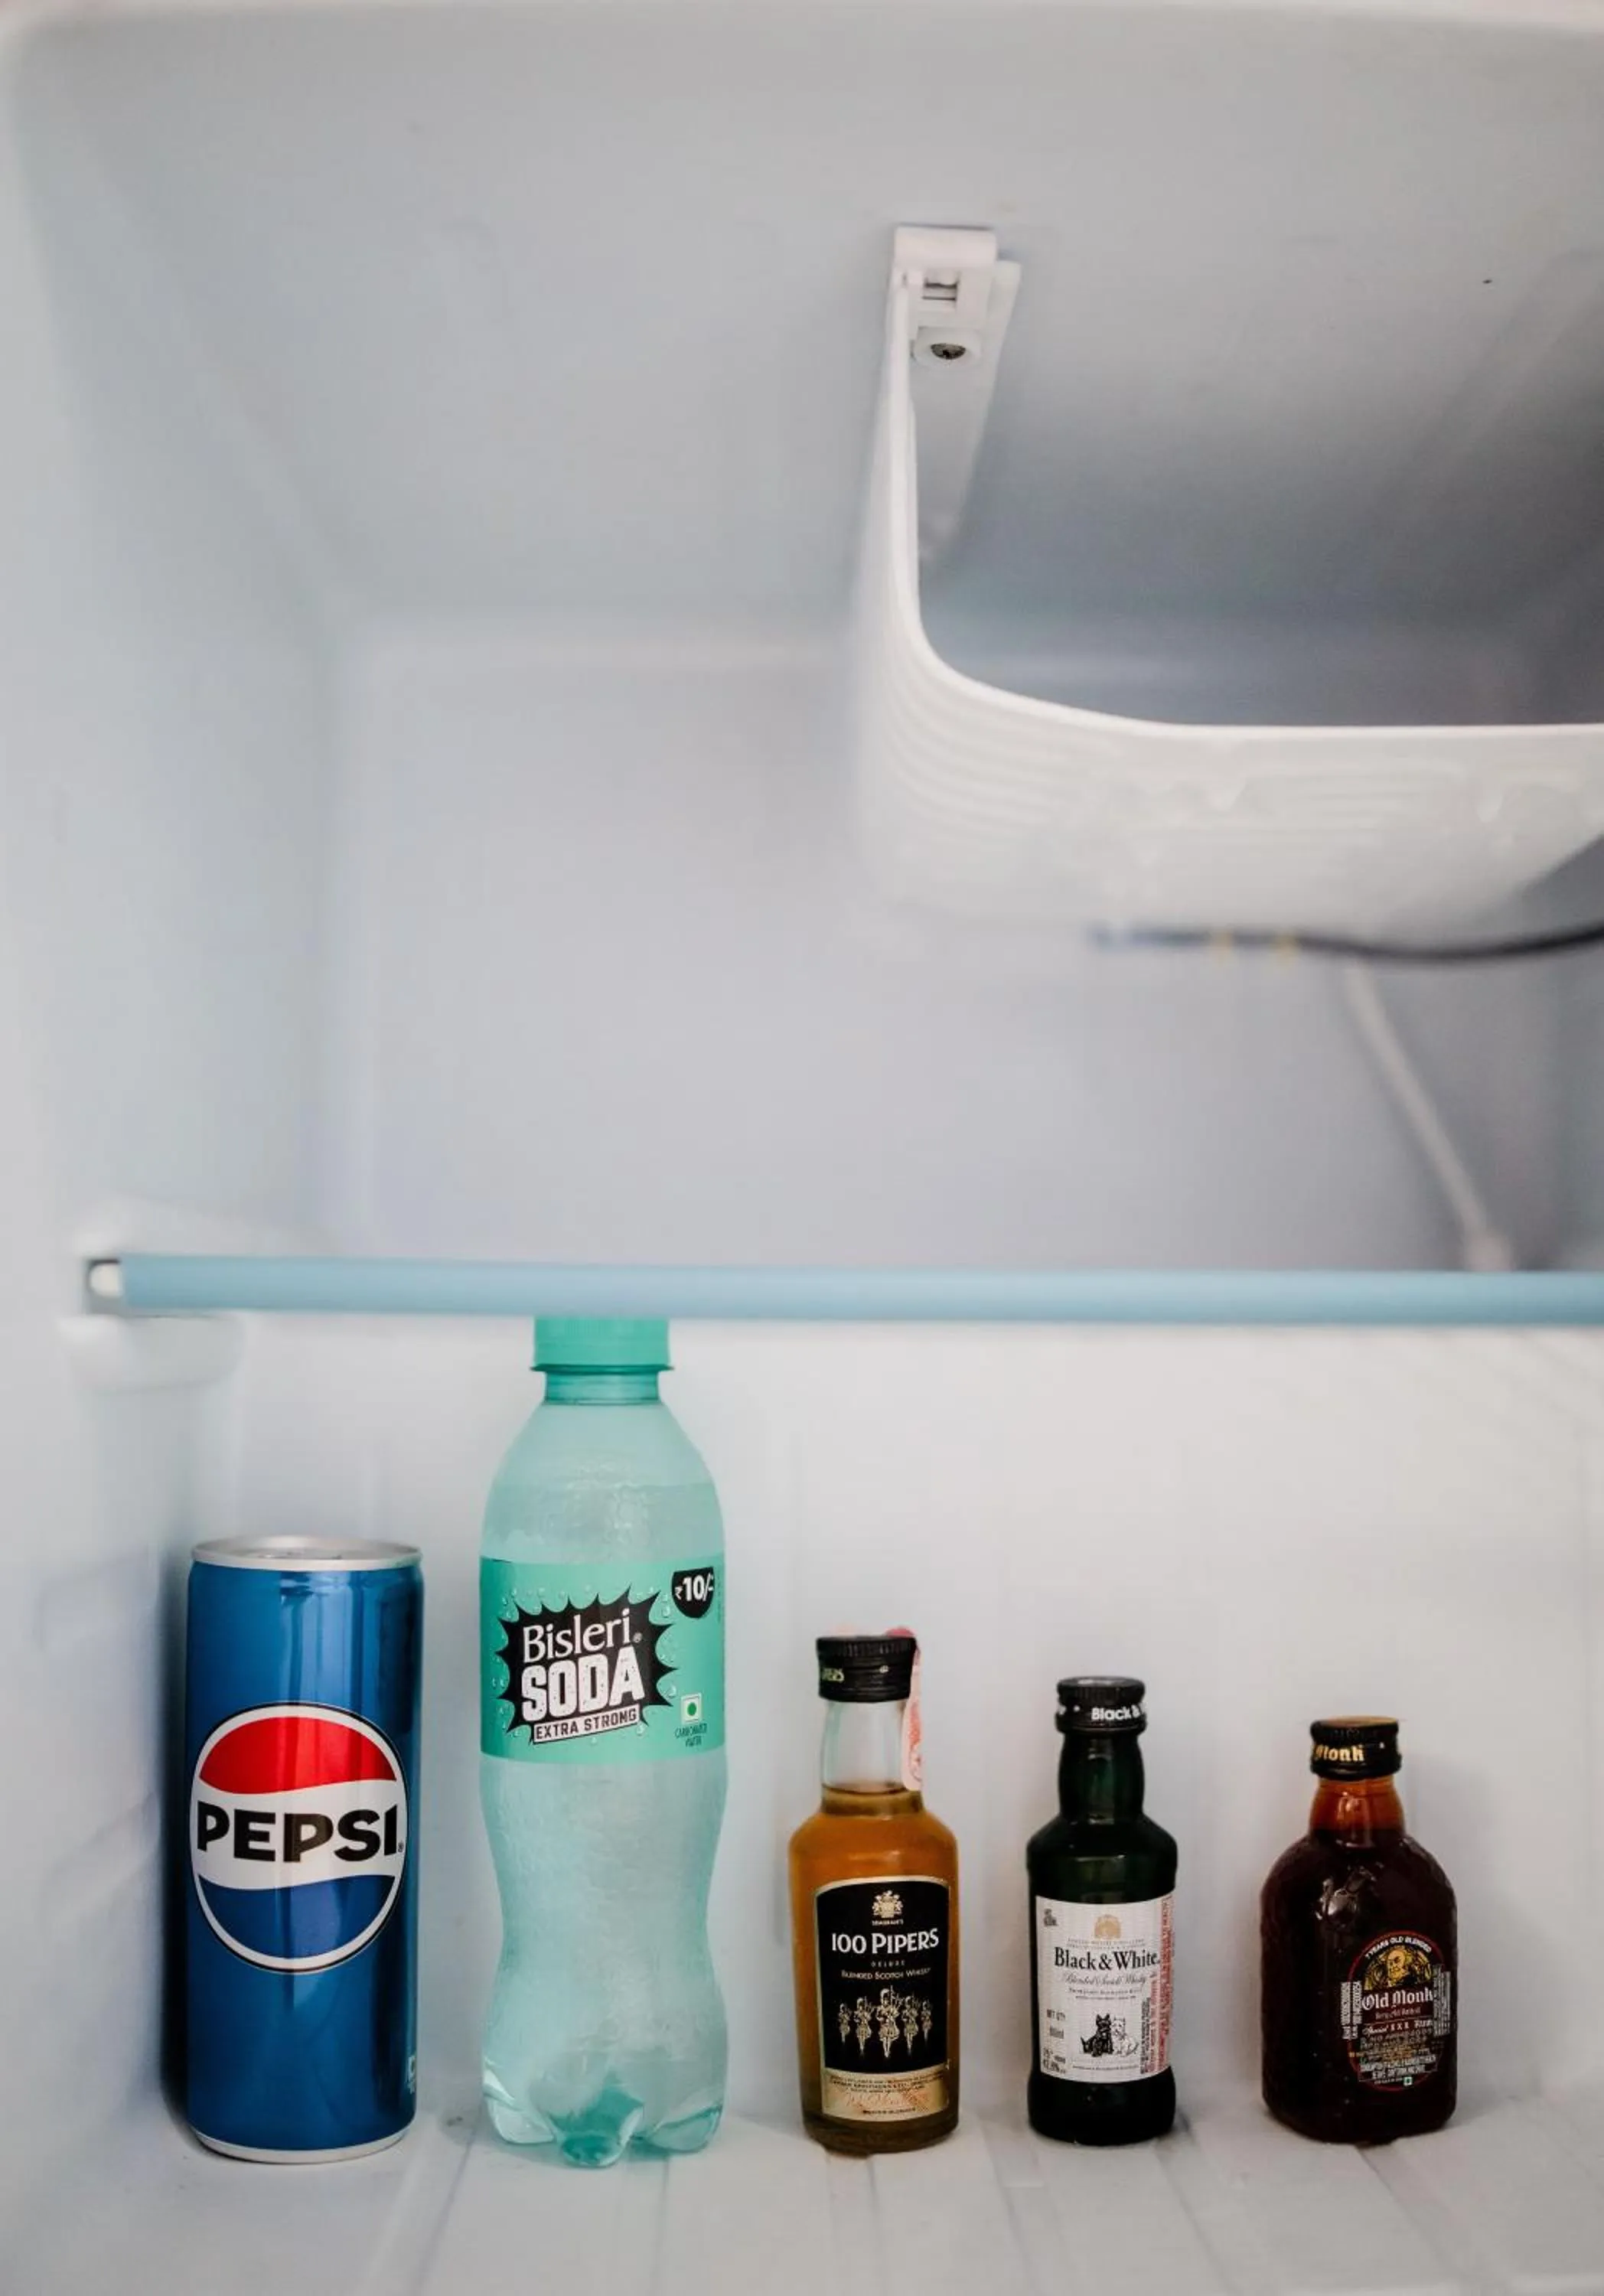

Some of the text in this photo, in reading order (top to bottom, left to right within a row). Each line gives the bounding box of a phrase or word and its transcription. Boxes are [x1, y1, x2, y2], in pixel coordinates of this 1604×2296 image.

[523, 1607, 631, 1663] Bisleri
[521, 1644, 645, 1721] SODA
[536, 1707, 637, 1740] EXTRA STRONG
[197, 1800, 397, 1862] PEPSI
[832, 1928, 940, 1954] 100 PIPERS
[1362, 1987, 1433, 2011] Old Monk
